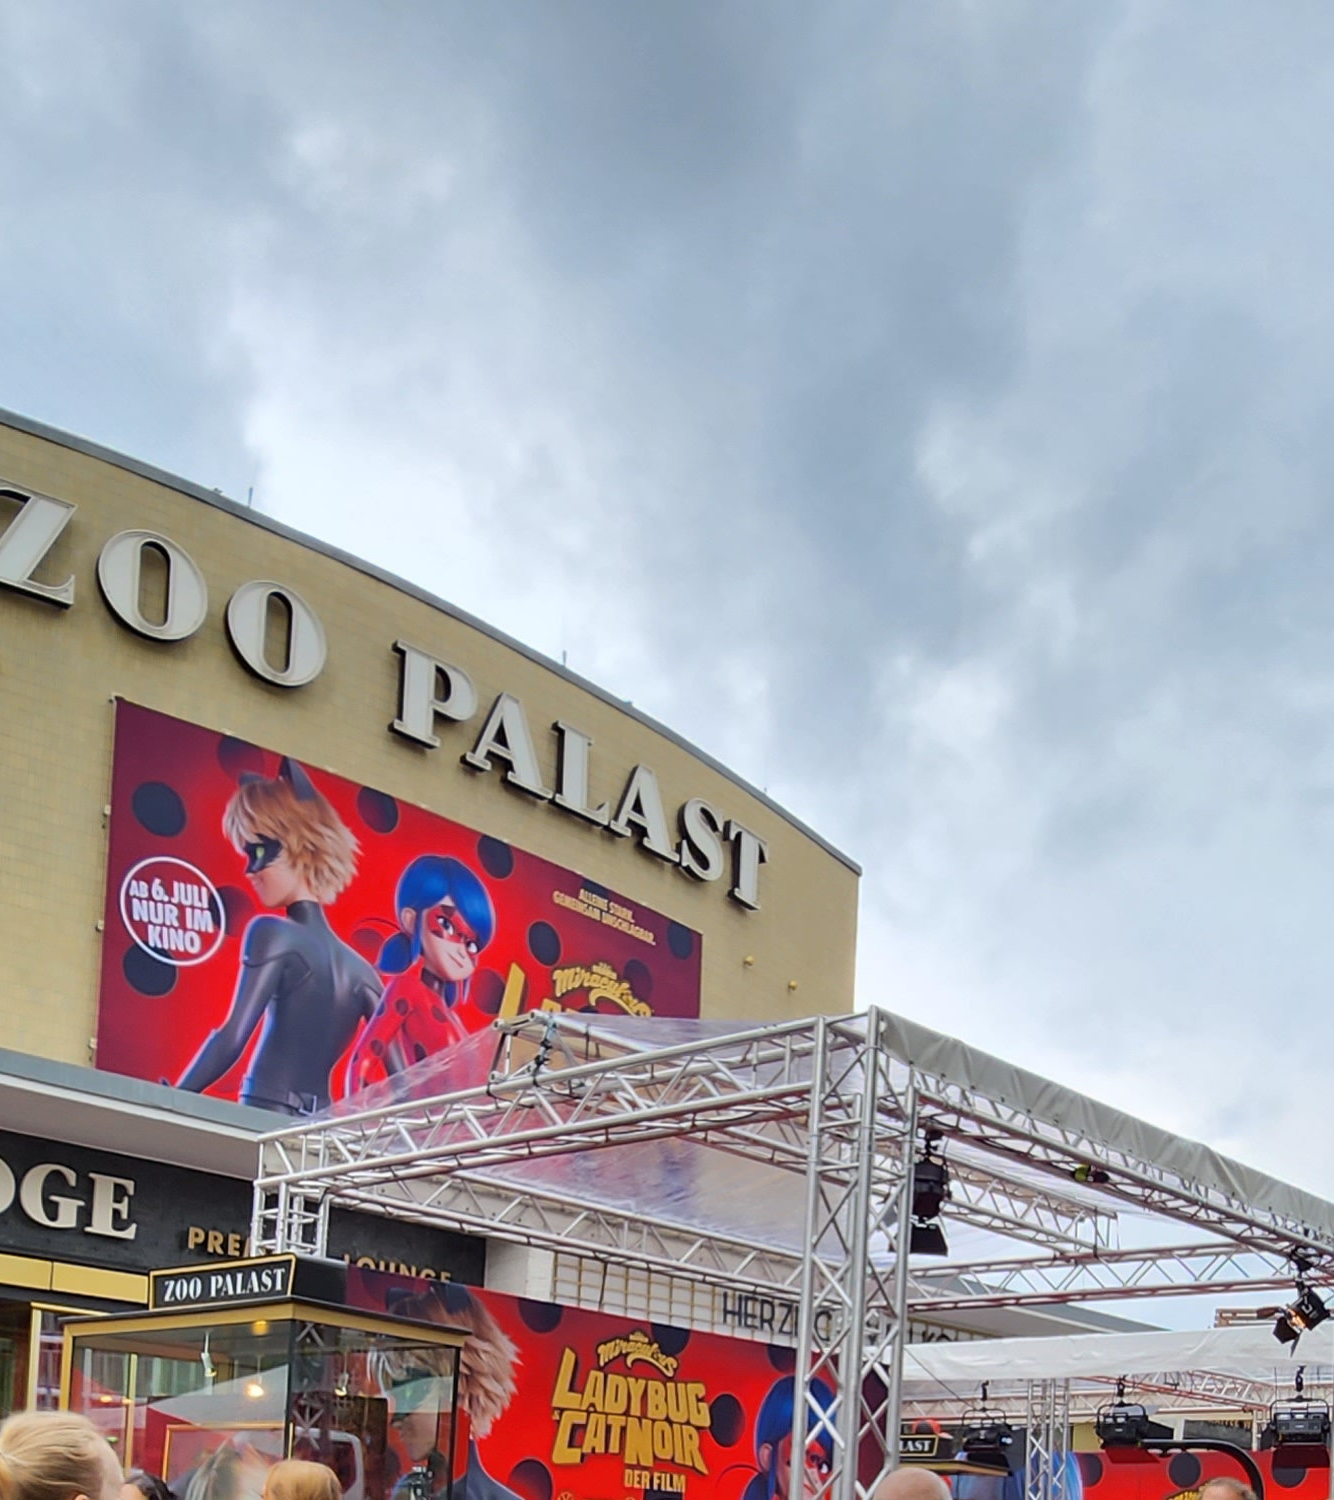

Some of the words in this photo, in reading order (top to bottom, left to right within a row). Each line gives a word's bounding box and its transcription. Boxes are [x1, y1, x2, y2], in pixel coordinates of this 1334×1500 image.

[387, 639, 769, 912] PALAST
[130, 879, 149, 898] AB
[151, 878, 169, 902] 6.
[171, 881, 209, 909] JULI
[132, 898, 179, 927] NUR
[186, 907, 214, 933] IM
[148, 924, 201, 954] KINO
[164, 1277, 203, 1302] ZOO
[210, 1268, 286, 1297] PALAST
[552, 1347, 711, 1428] LADYBUG
[900, 1440, 931, 1452] LAST
[624, 1469, 651, 1489] DER
[653, 1473, 686, 1492] FILM
